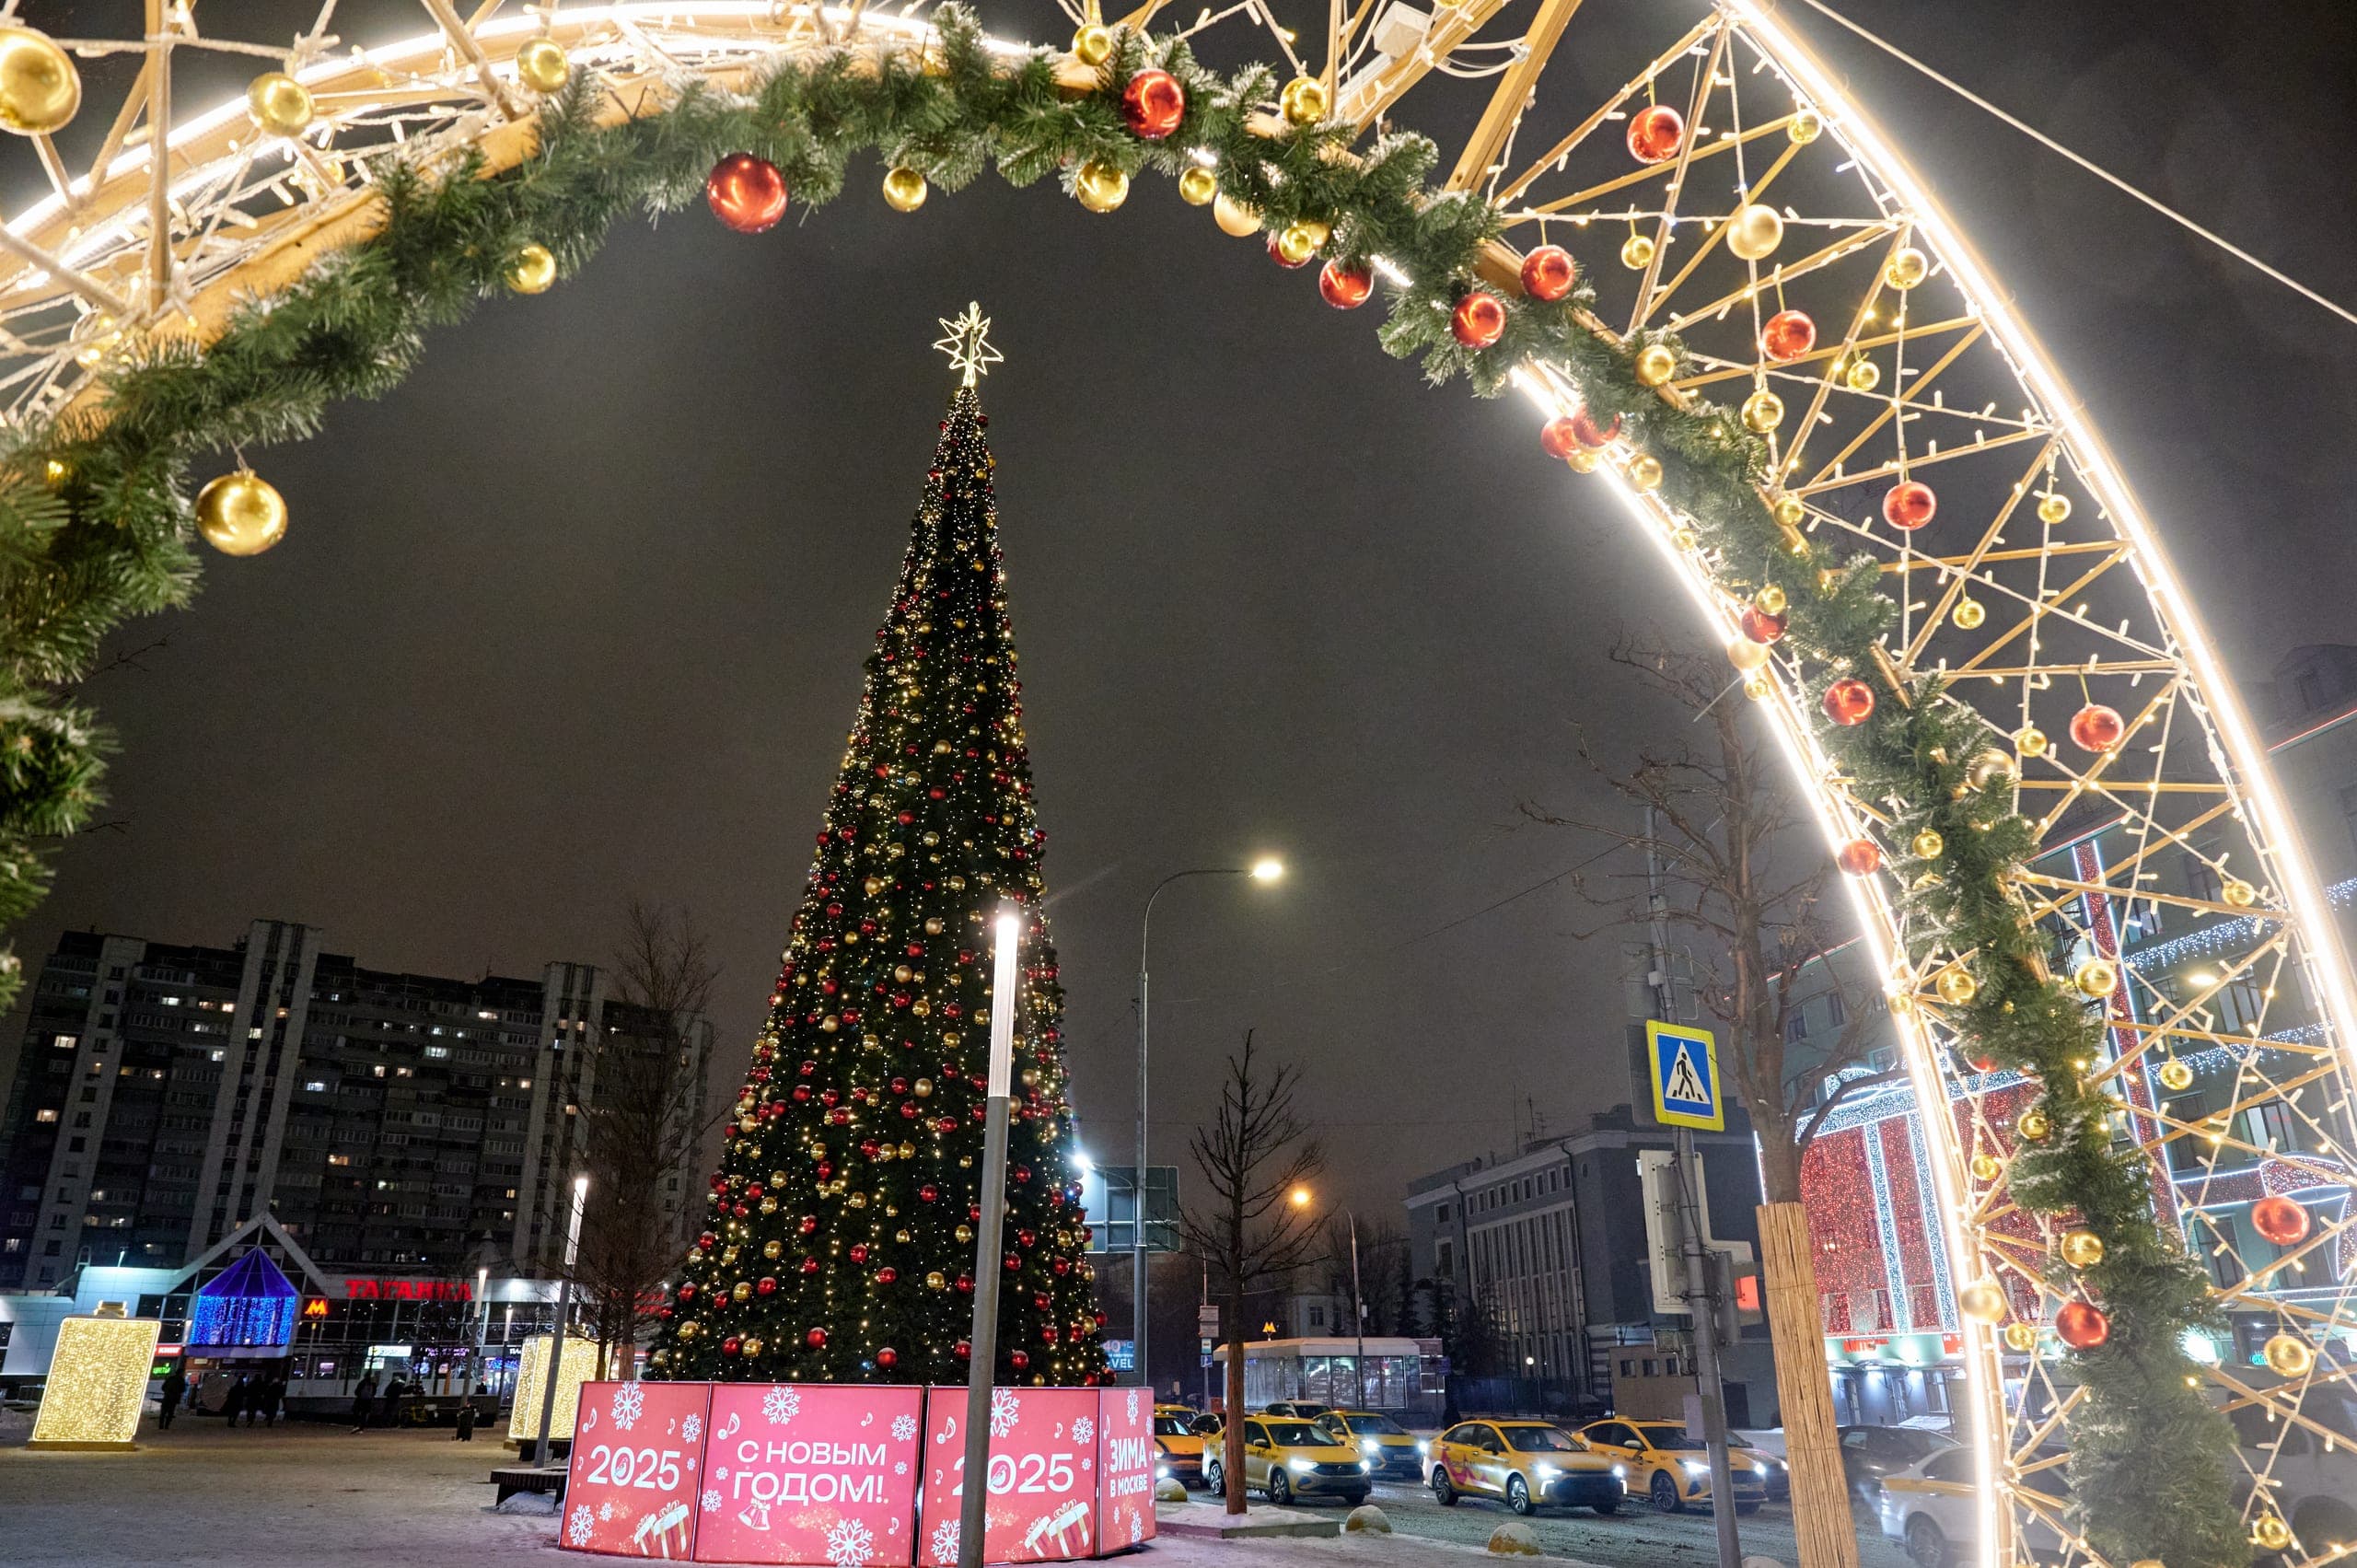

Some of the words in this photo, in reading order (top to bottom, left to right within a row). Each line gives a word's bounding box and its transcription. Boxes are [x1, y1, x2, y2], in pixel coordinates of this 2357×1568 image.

[345, 1279, 472, 1301] ТАГАНКА
[737, 1440, 760, 1463] С
[765, 1441, 887, 1466] НОВЫМ
[1109, 1437, 1147, 1473] ЗИМА
[587, 1445, 681, 1492] 2025
[733, 1471, 885, 1506] ГОДОМ!
[1109, 1479, 1116, 1498] В
[1117, 1473, 1148, 1496] МОСКВЕ
